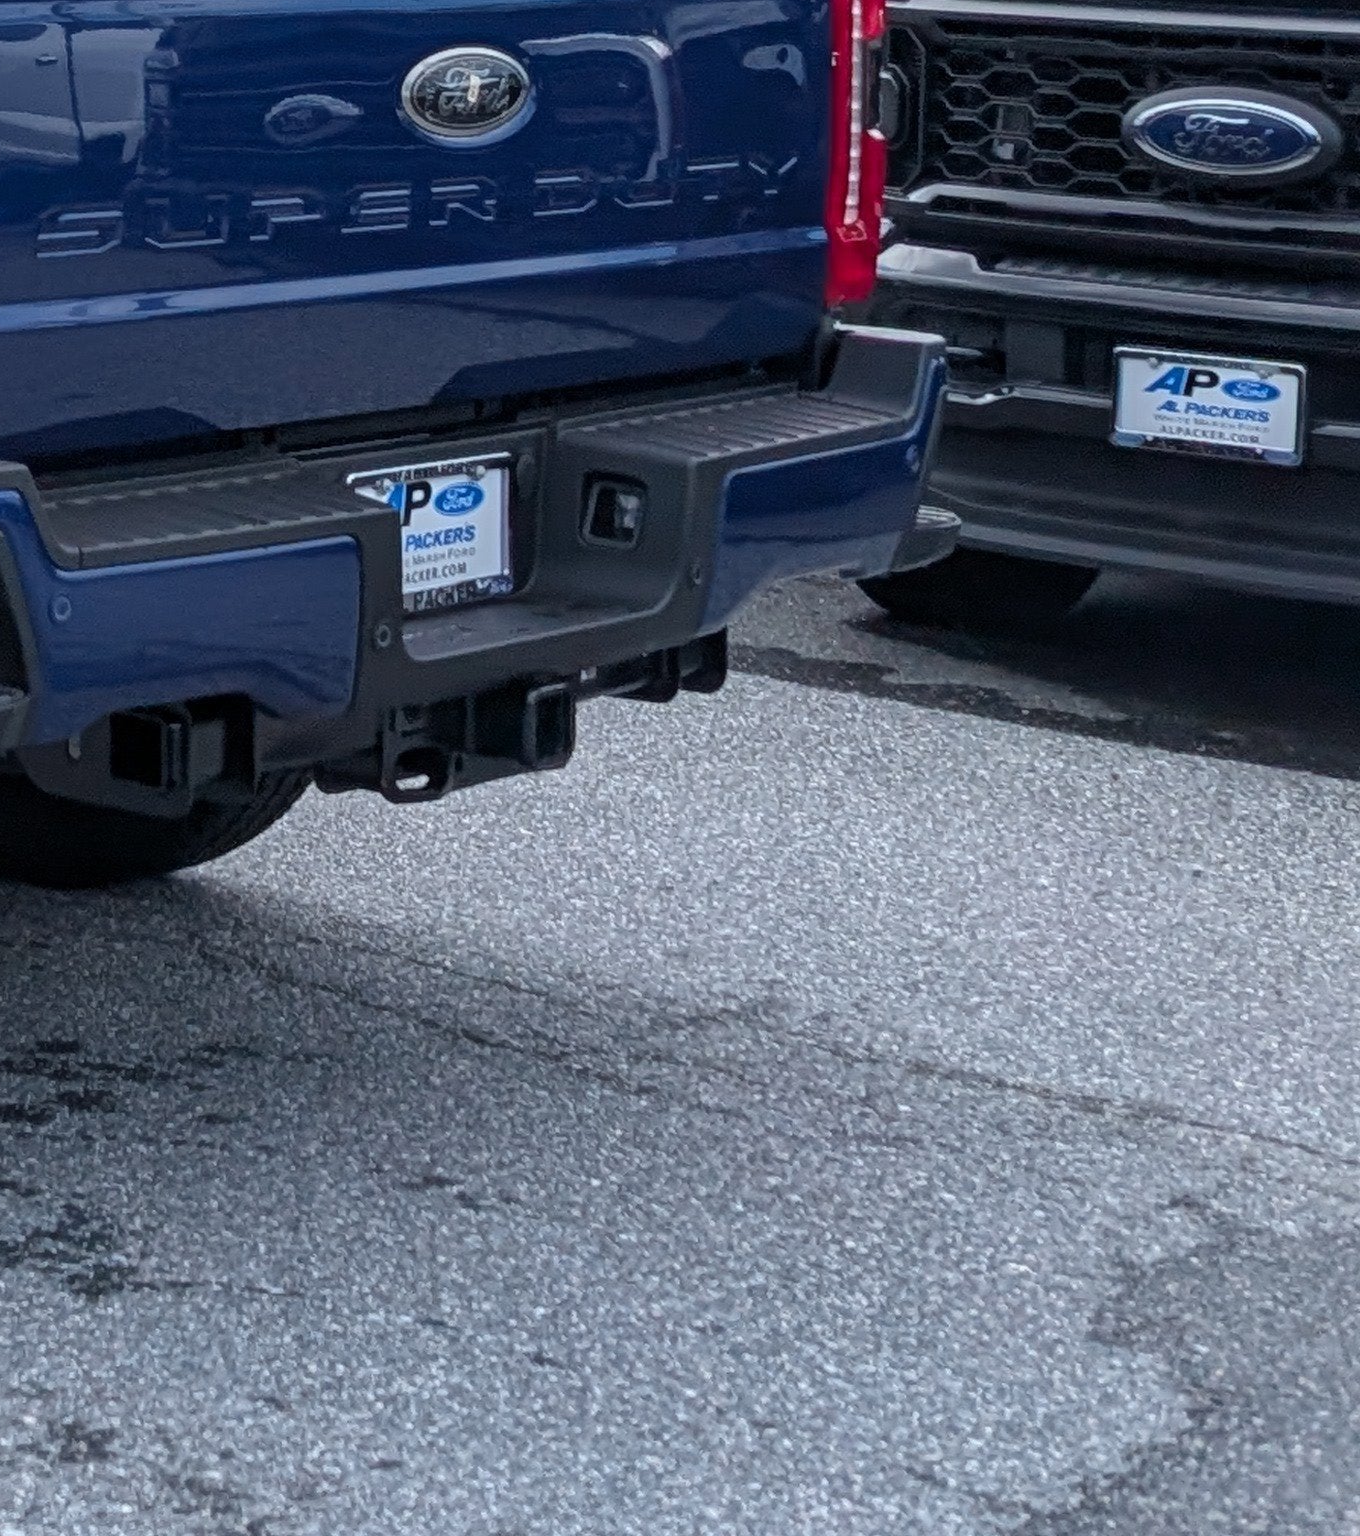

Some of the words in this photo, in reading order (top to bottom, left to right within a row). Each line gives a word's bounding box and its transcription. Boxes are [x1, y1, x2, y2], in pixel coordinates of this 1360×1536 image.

[1173, 112, 1276, 158] Ford
[36, 174, 498, 259] SUPER
[532, 154, 800, 217] DUTY
[1144, 366, 1220, 397] AP
